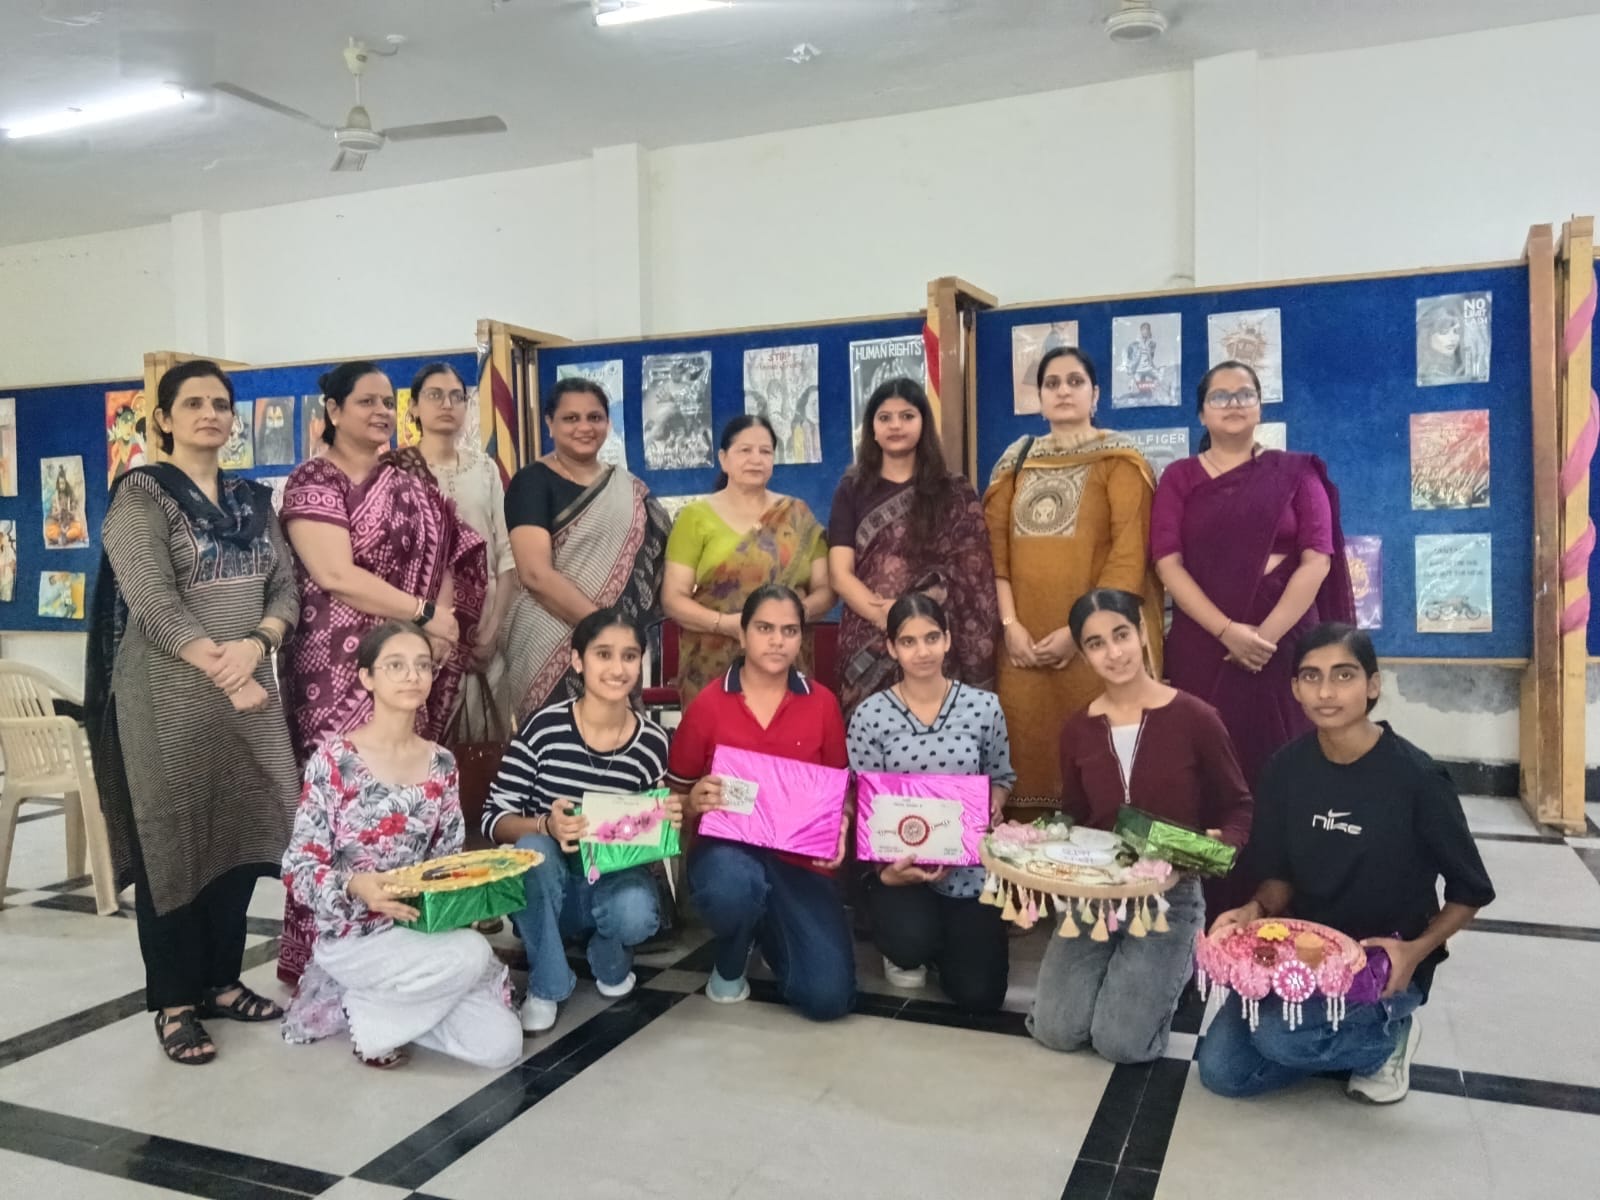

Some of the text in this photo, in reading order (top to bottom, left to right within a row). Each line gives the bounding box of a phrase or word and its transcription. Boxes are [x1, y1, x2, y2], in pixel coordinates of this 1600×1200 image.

[1464, 298, 1486, 310] NO
[856, 341, 922, 360] HUMAN RIGHTS
